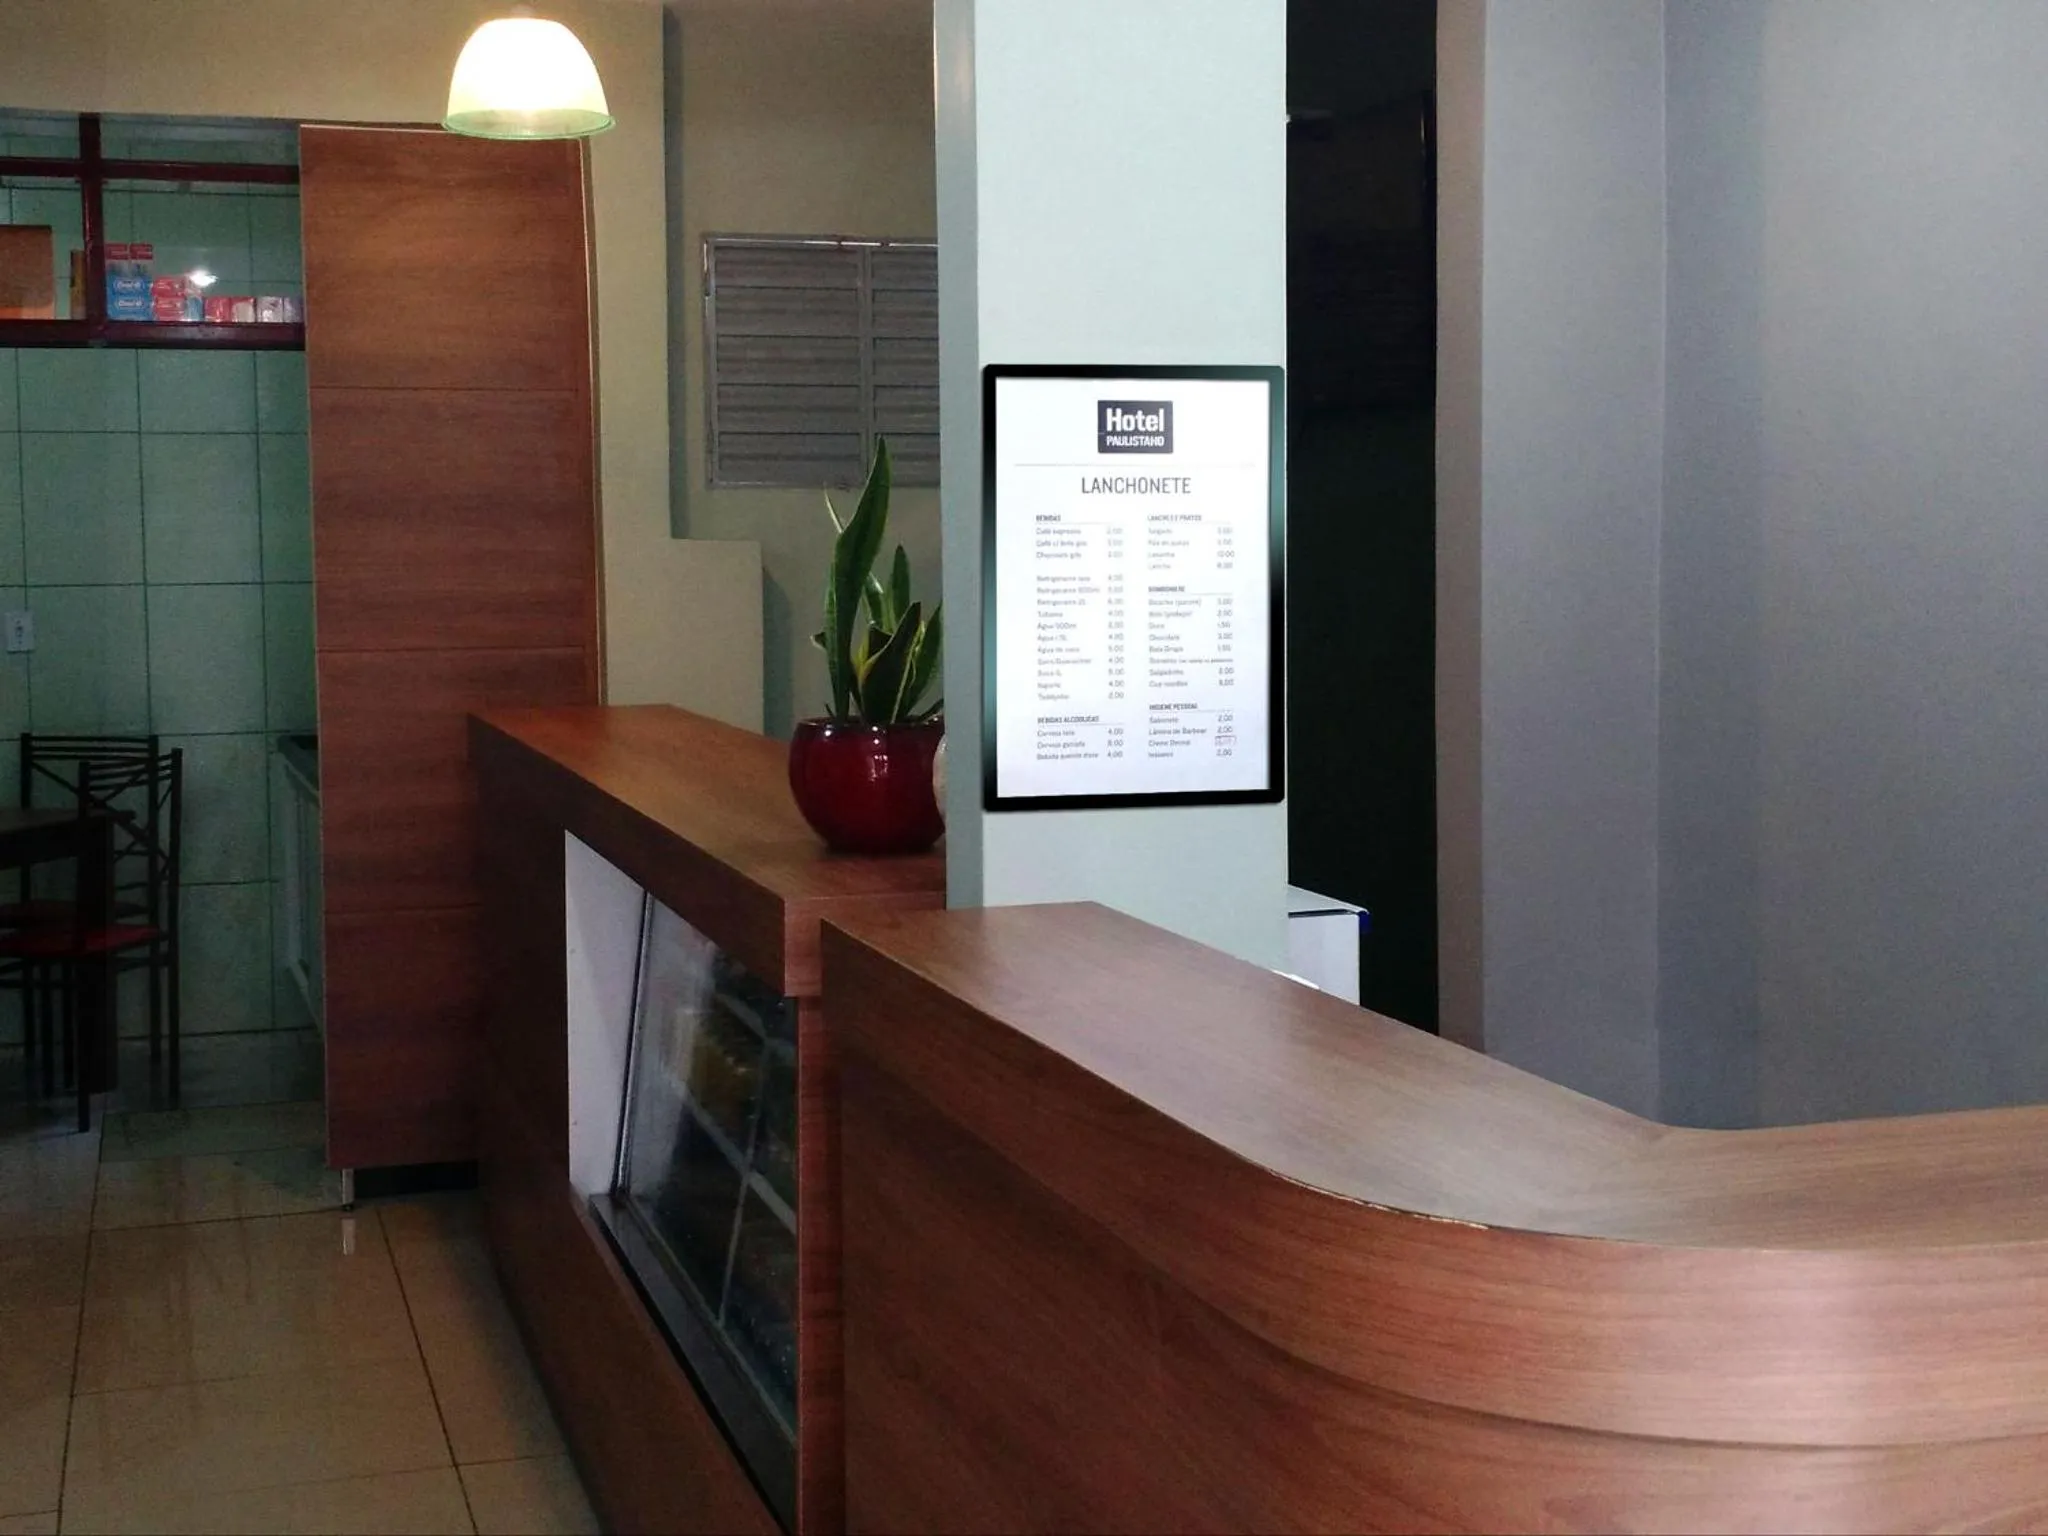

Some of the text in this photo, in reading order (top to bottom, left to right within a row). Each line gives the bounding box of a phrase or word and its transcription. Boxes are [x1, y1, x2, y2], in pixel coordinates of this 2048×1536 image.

[1106, 407, 1165, 432] Hotel
[1106, 435, 1165, 447] PAULISTANO
[1081, 476, 1192, 494] LANCHONETE
